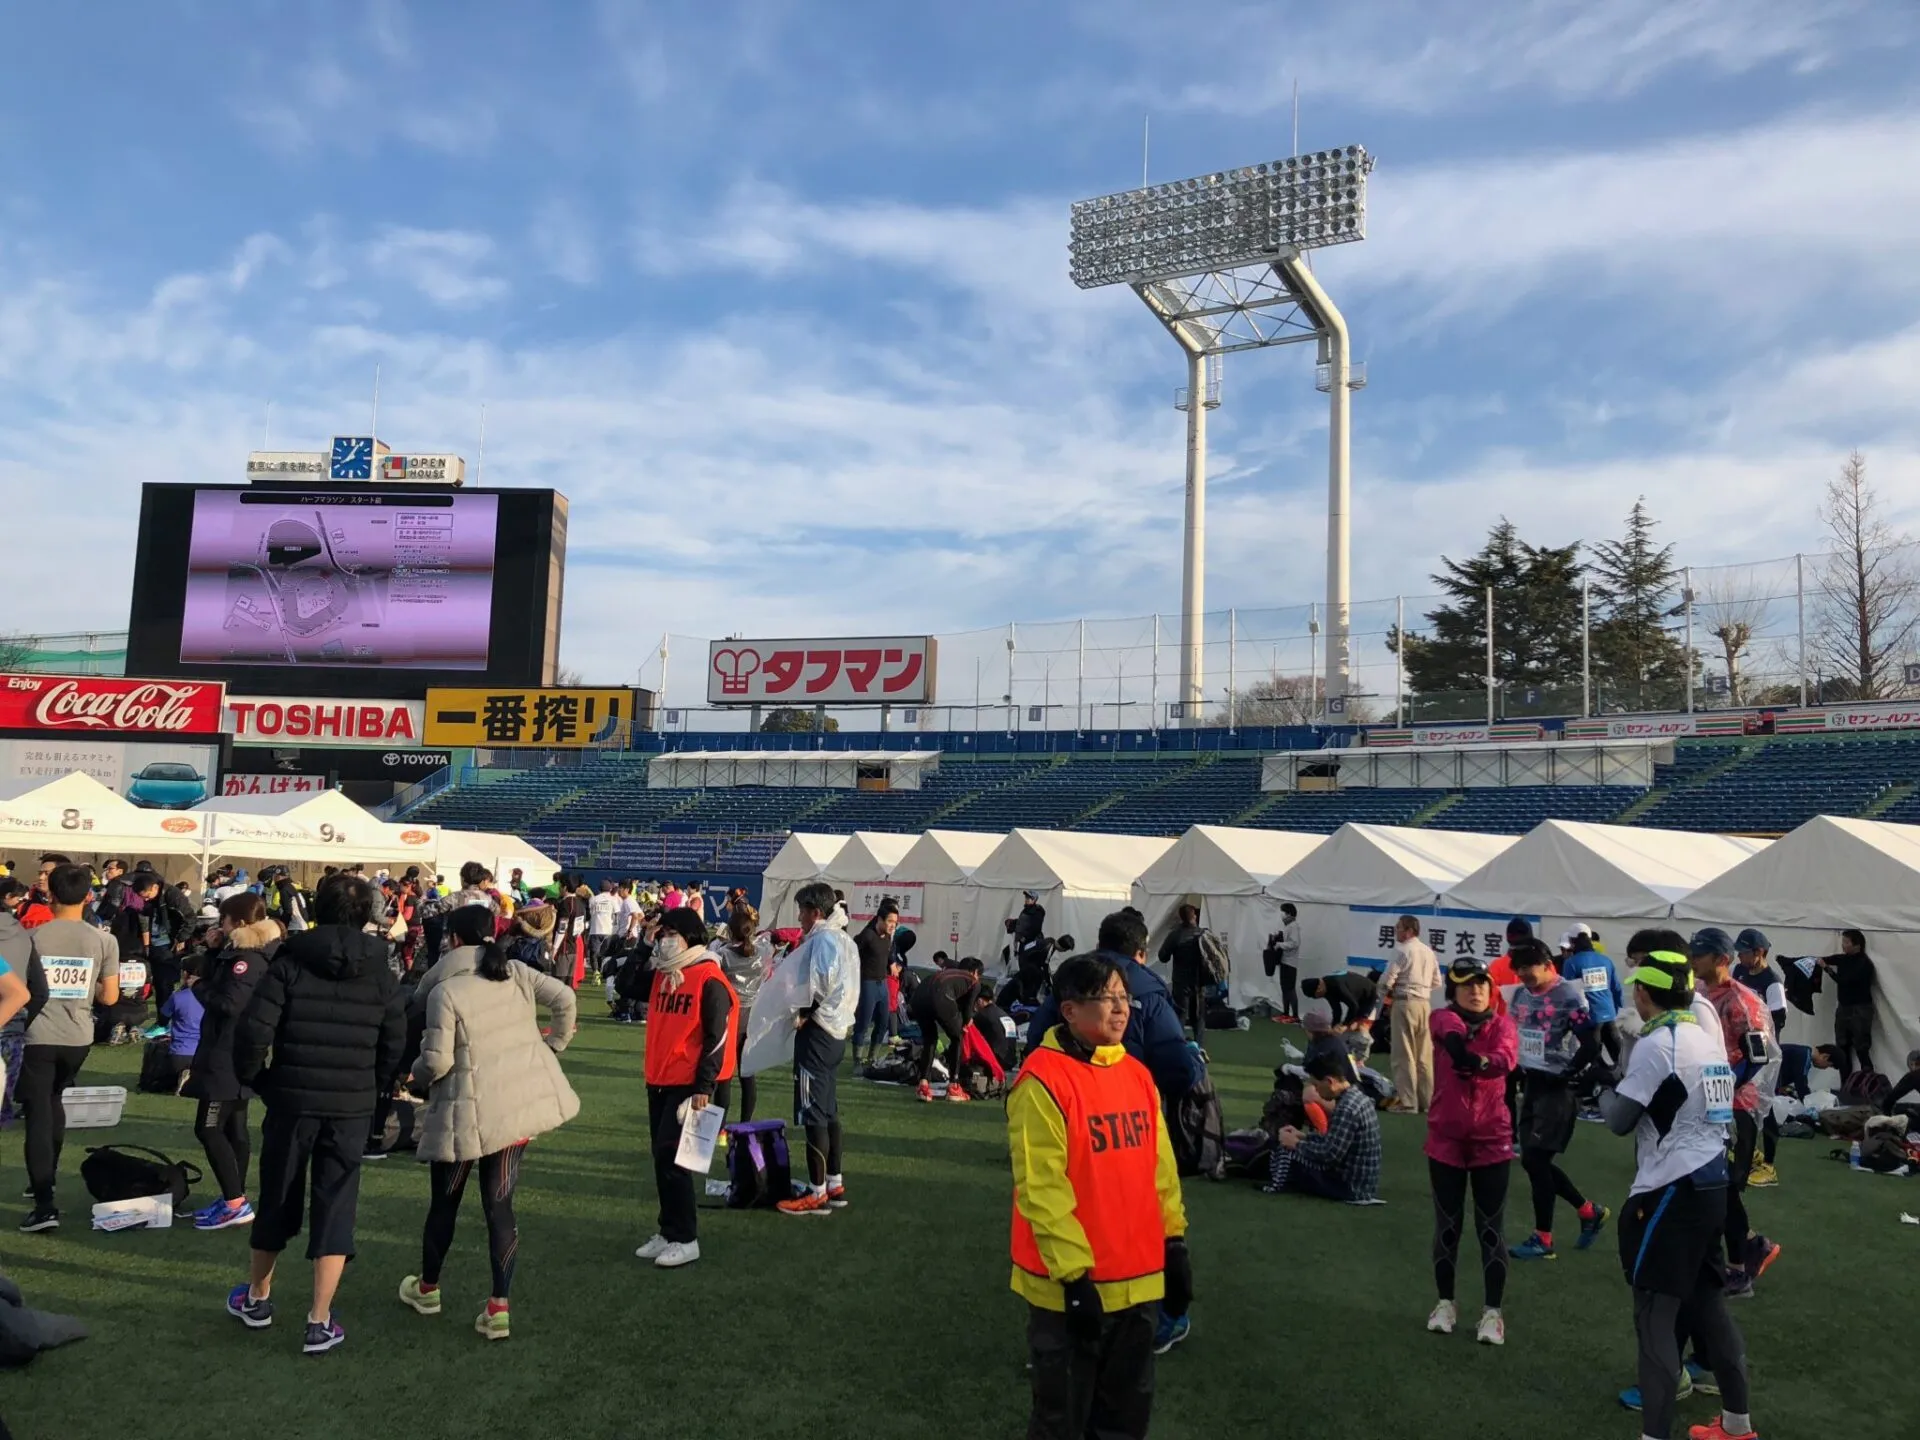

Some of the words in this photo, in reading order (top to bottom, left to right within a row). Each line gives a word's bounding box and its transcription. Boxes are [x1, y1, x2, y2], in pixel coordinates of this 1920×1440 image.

[411, 458, 446, 467] OPEN
[409, 470, 445, 479] HOUSE
[762, 649, 923, 694] タフマン
[8, 677, 43, 691] Enjoy
[36, 681, 202, 730] Coca-Cola
[1527, 691, 1535, 704] F
[1332, 700, 1342, 713] G
[229, 703, 415, 739] TOSHIBA
[437, 695, 619, 742] 一番搾り
[402, 754, 449, 765] TOYOTA
[1378, 925, 1503, 958] 男更衣室
[53, 968, 87, 985] 3034
[1087, 1110, 1150, 1152] STAFF
